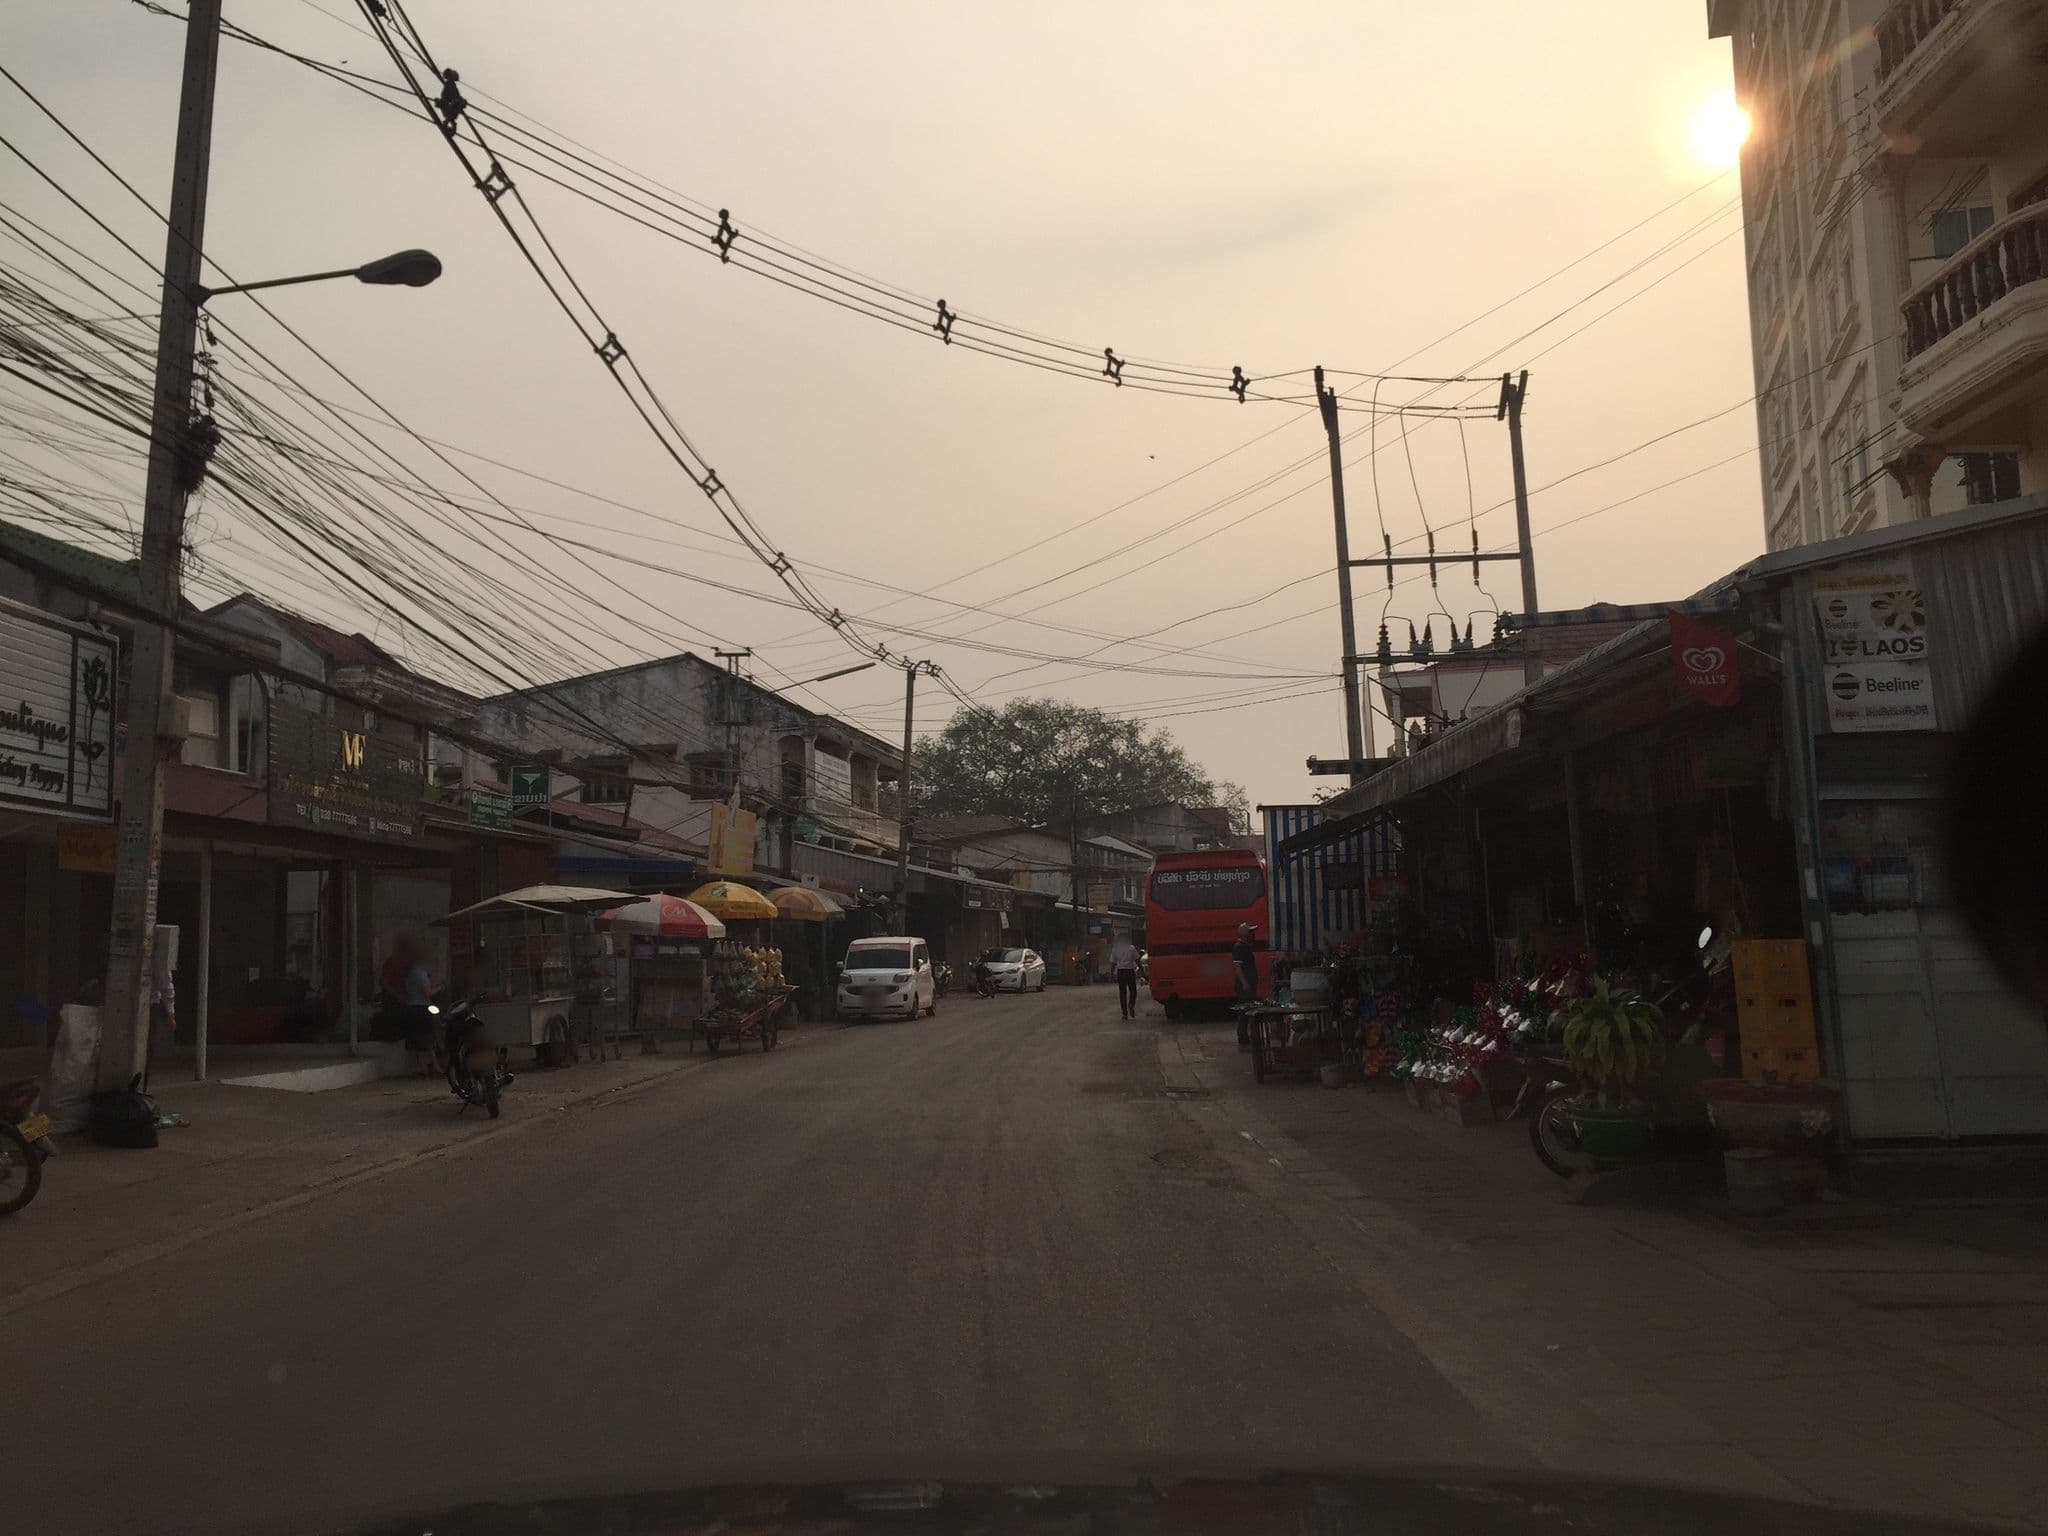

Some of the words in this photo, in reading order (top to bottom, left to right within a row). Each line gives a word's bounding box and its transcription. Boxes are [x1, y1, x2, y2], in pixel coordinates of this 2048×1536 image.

[1830, 640, 1837, 656] I
[1862, 636, 1924, 656] LAOS
[1866, 678, 1920, 692] Beeline
